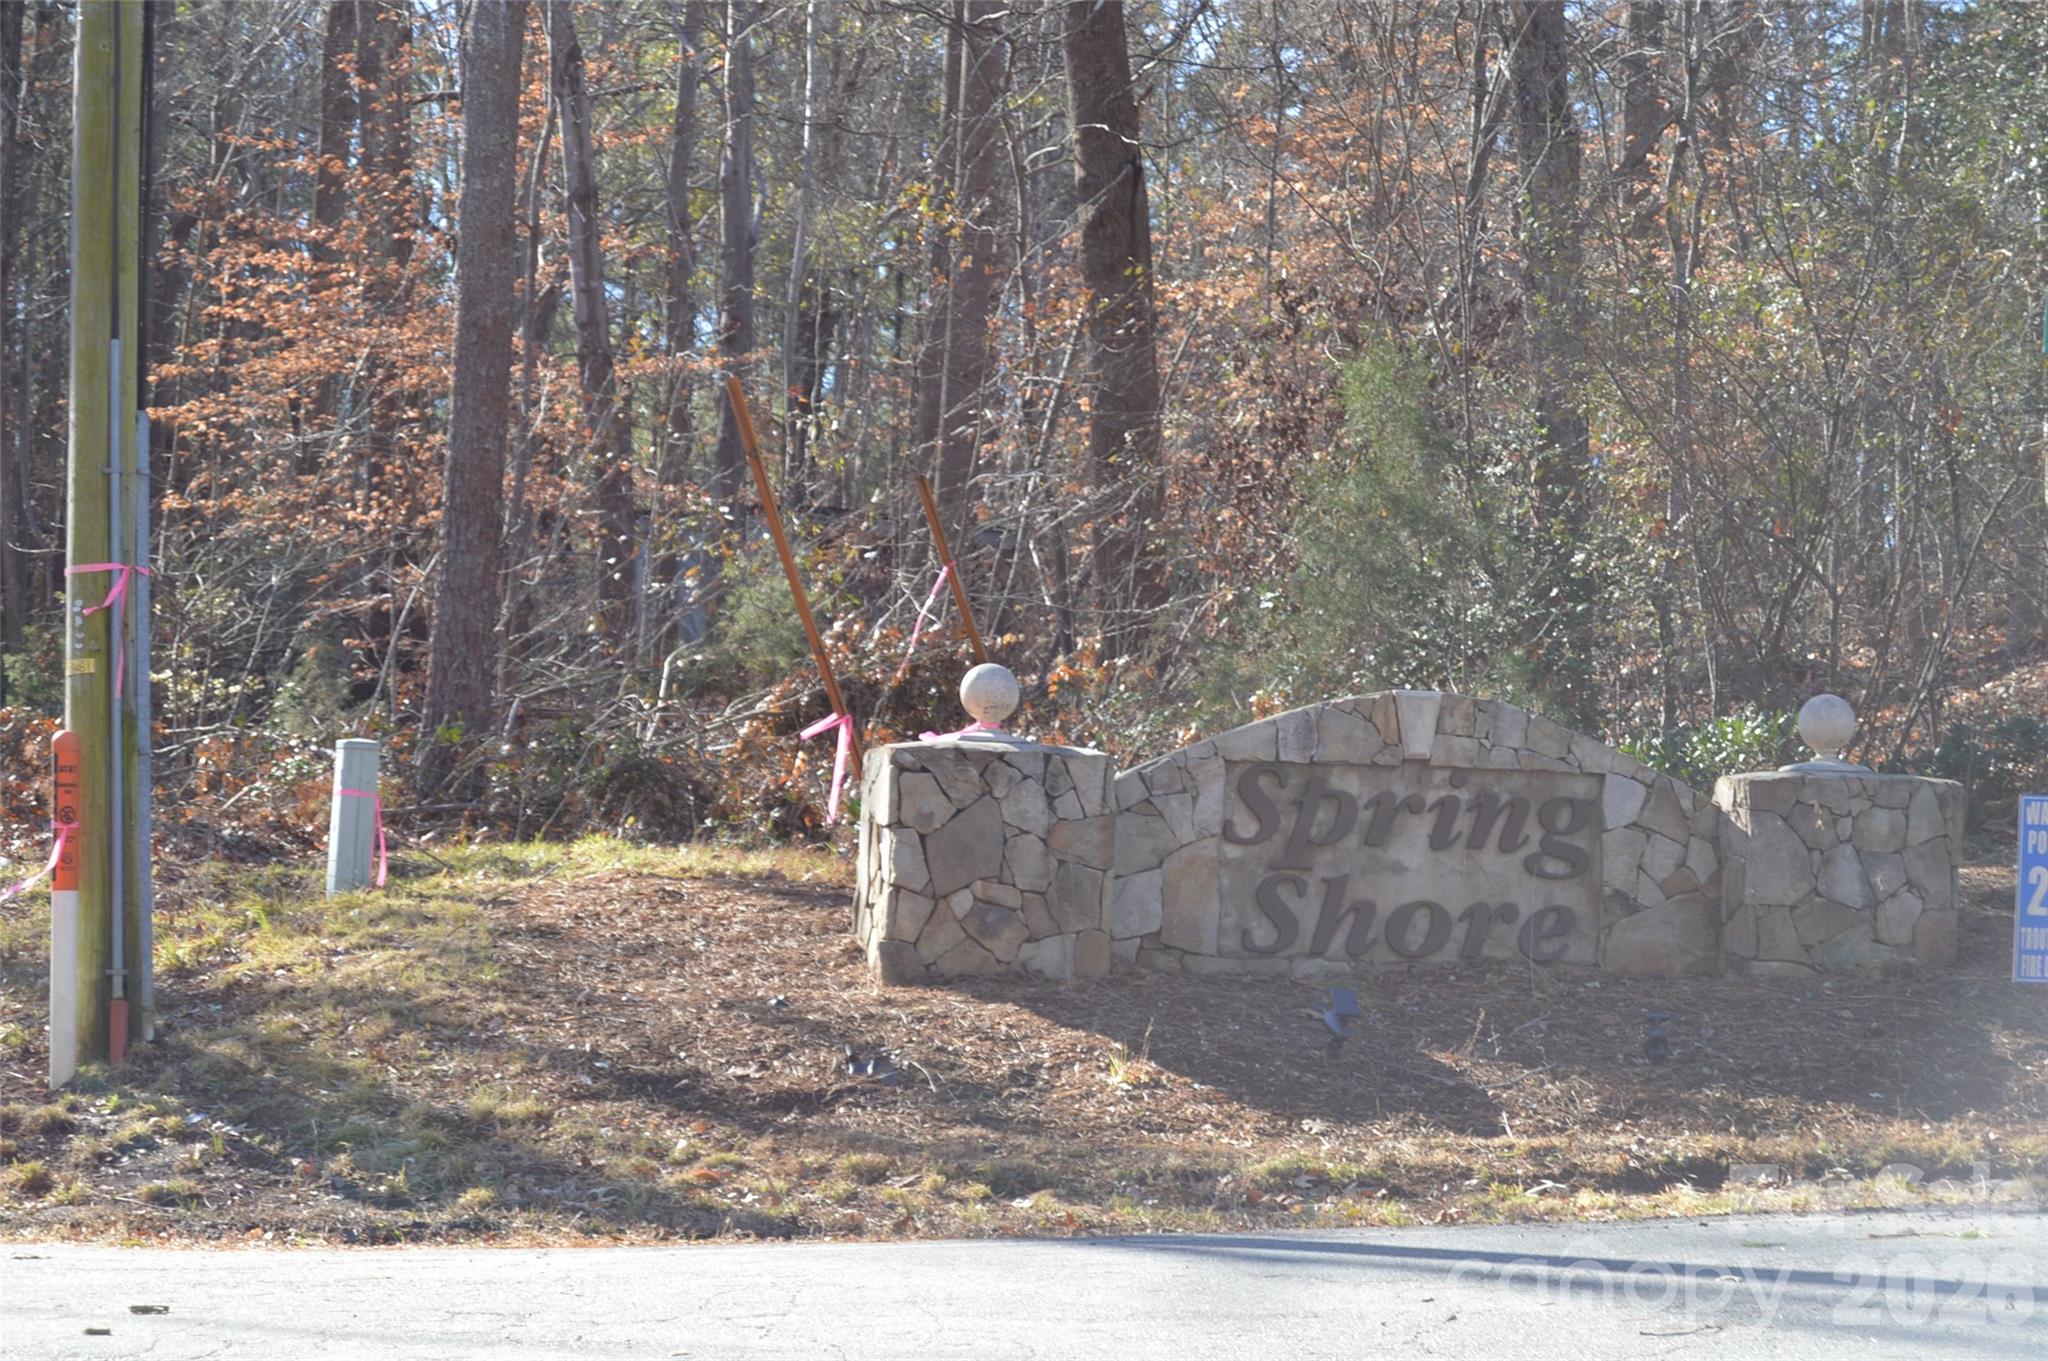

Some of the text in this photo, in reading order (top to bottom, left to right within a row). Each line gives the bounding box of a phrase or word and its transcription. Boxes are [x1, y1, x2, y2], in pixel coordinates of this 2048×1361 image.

[1222, 763, 1597, 880] Spring
[1241, 872, 1577, 962] Shore
[2027, 865, 2048, 916] 2
[2020, 928, 2048, 949] TROU
